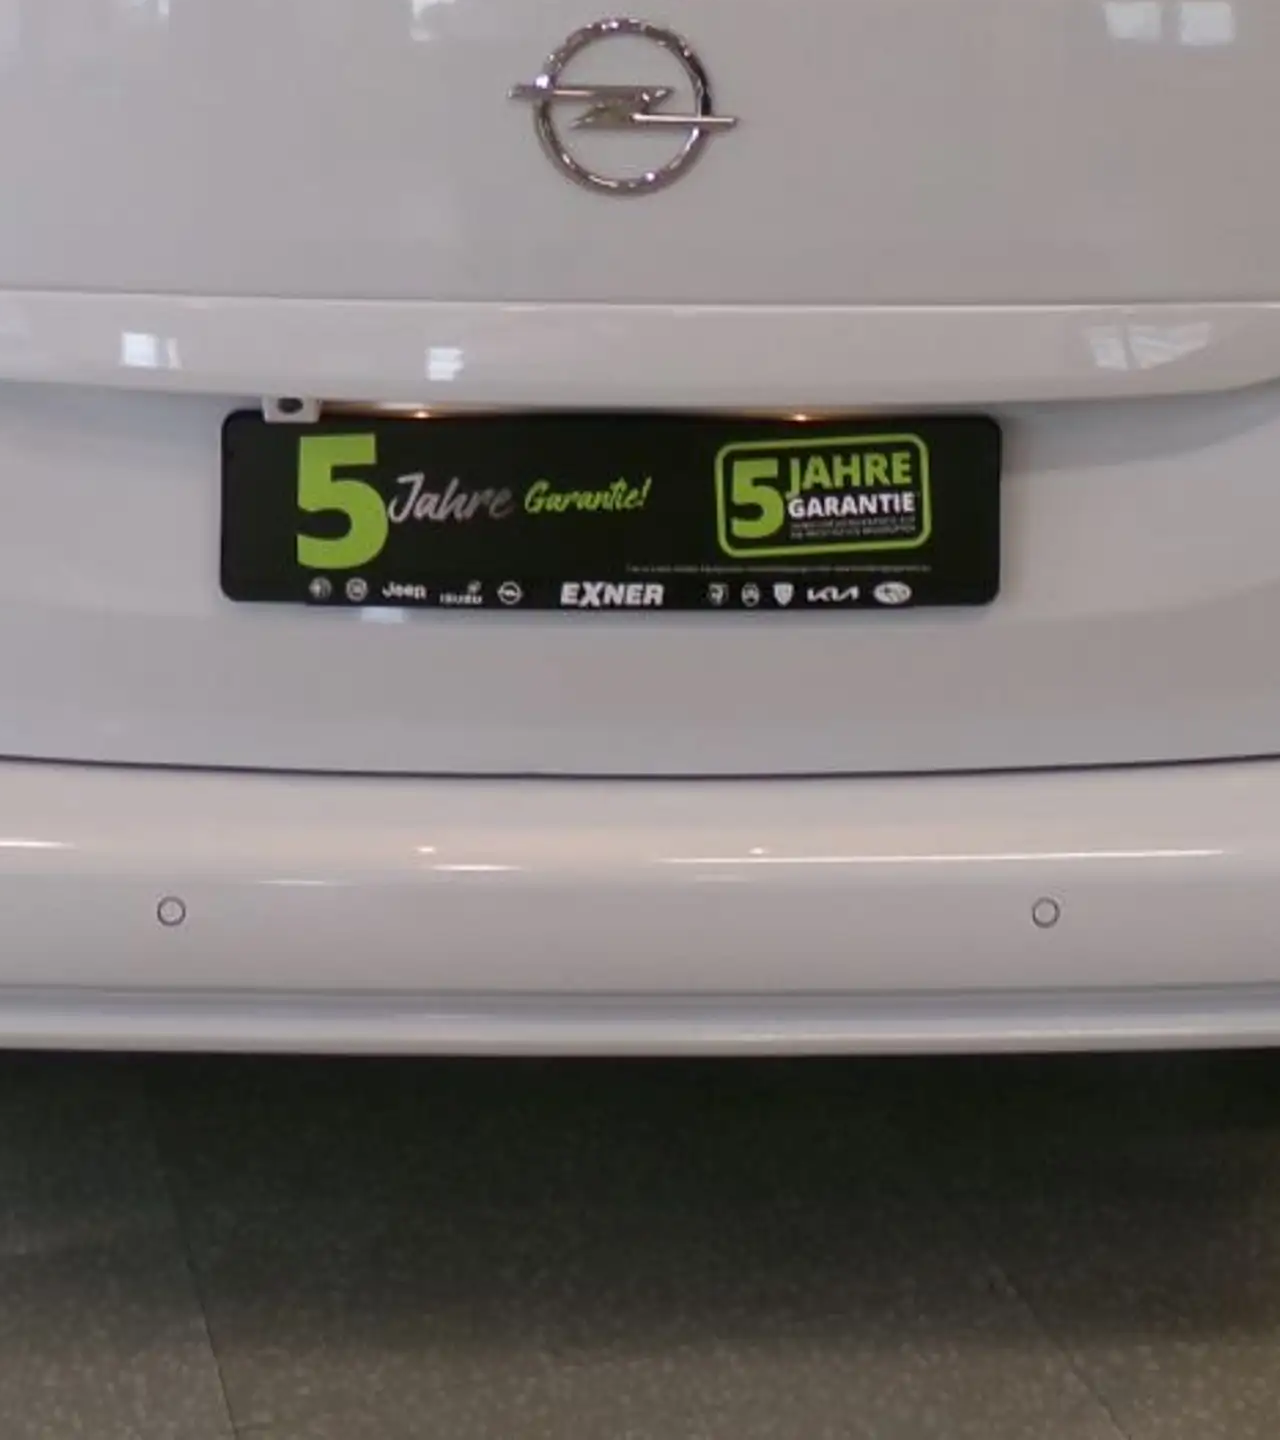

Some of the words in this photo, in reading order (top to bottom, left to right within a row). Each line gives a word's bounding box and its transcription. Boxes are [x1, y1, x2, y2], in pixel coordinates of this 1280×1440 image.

[297, 433, 389, 570] 5
[387, 472, 516, 523] Jahre
[524, 476, 652, 515] Garantie!
[731, 457, 784, 539] 5
[786, 451, 912, 500] JAHRE
[788, 492, 916, 518] GARANTIE
[382, 581, 427, 600] Jeep
[560, 581, 665, 607] EXNER
